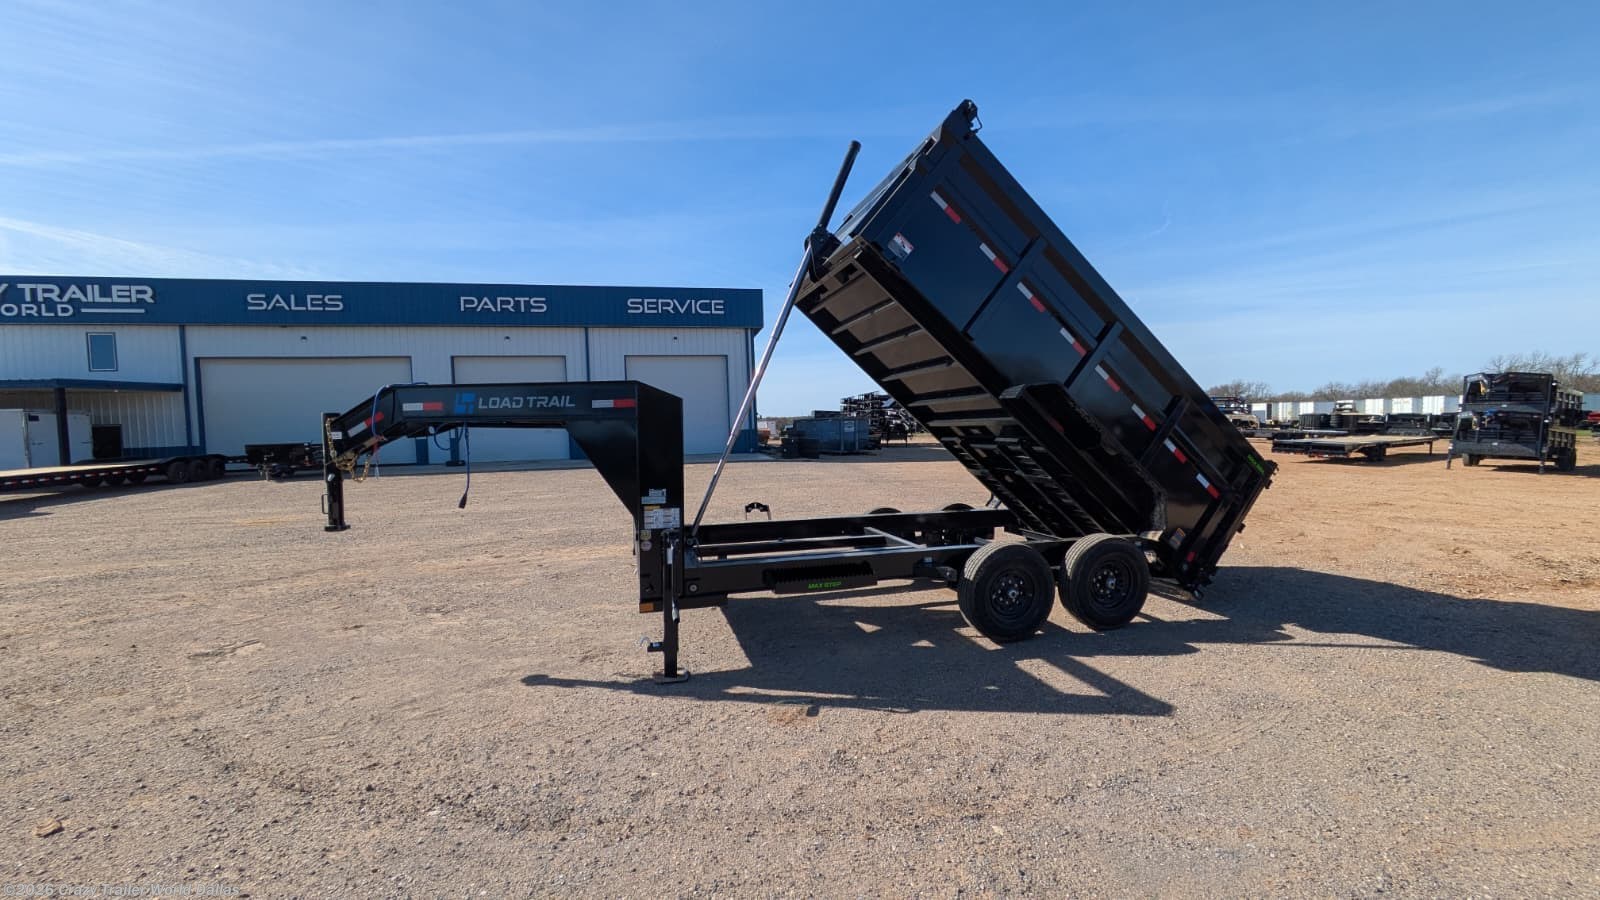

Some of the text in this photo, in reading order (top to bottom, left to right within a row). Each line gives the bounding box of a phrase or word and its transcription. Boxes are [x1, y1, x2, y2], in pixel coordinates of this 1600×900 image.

[16, 284, 154, 302] TRAILER
[247, 294, 344, 311] SALES
[460, 296, 547, 313] PARTS
[627, 298, 725, 315] SERVICE
[478, 395, 576, 409] LOAD TRAIL
